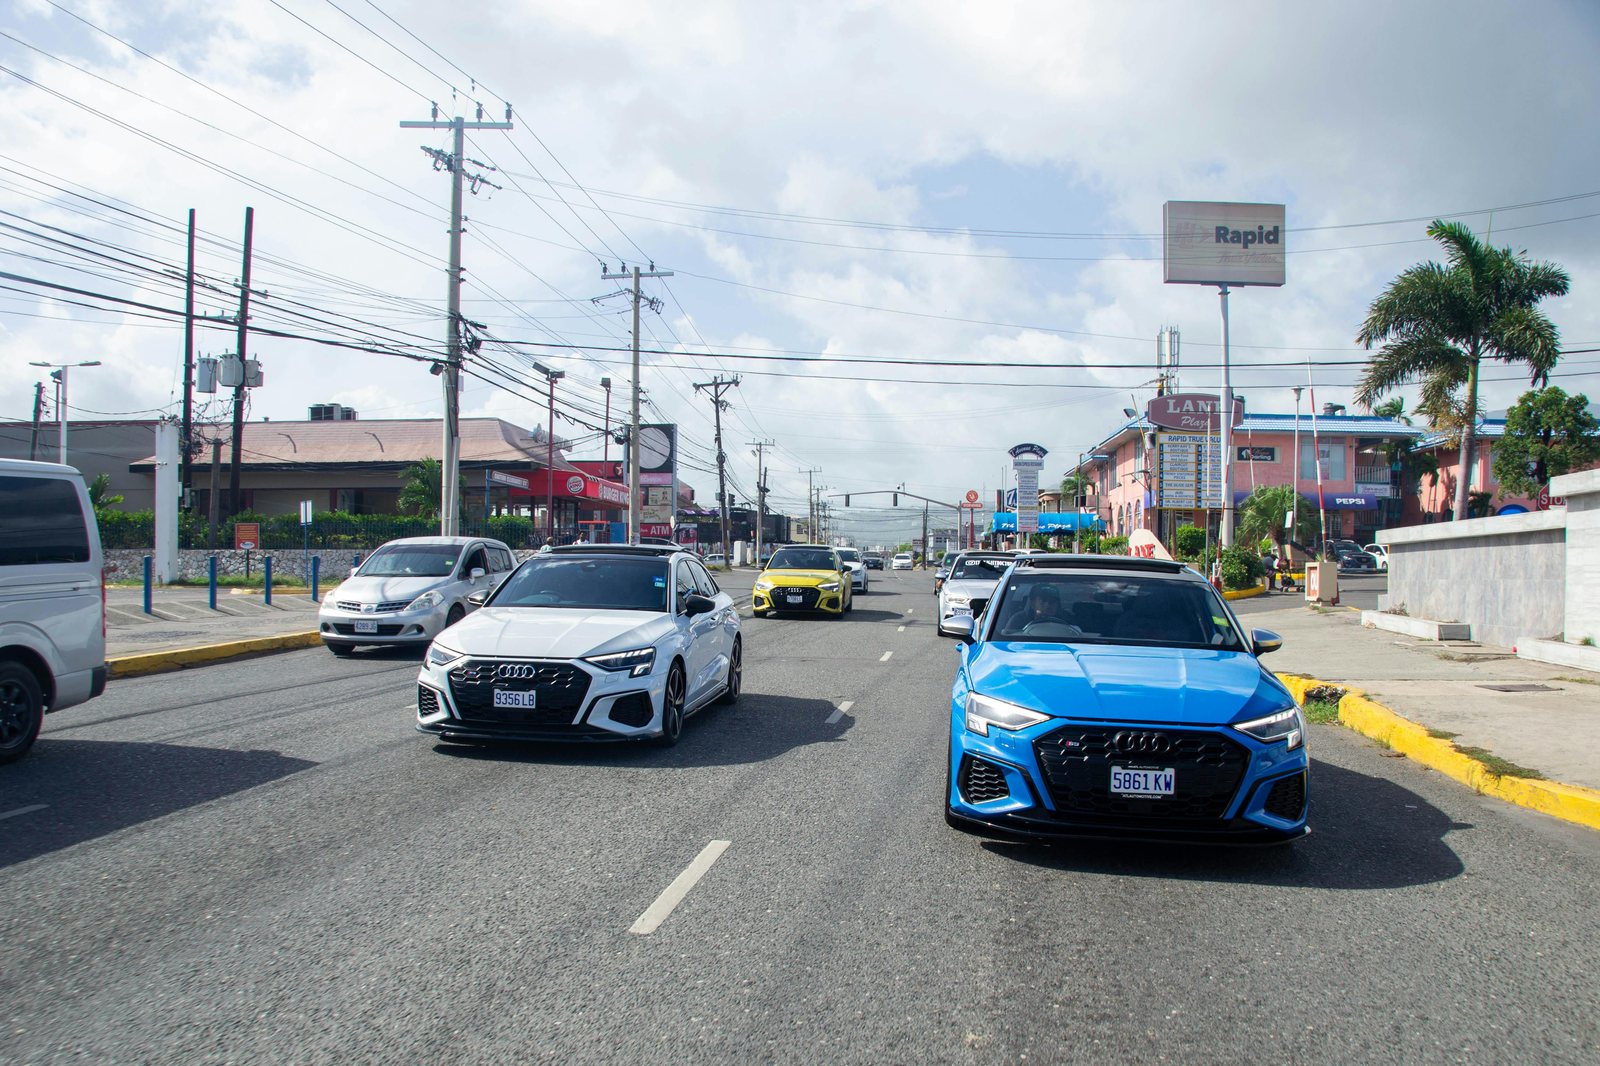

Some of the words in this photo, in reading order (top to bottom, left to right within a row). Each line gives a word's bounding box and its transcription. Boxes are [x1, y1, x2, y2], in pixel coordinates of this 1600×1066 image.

[1215, 225, 1279, 249] Rapid
[1168, 435, 1187, 443] RAPID
[650, 526, 670, 535] ATM
[495, 692, 520, 706] 9356
[522, 693, 534, 706] LB
[1113, 772, 1149, 790] 5861
[1154, 773, 1172, 791] KW
